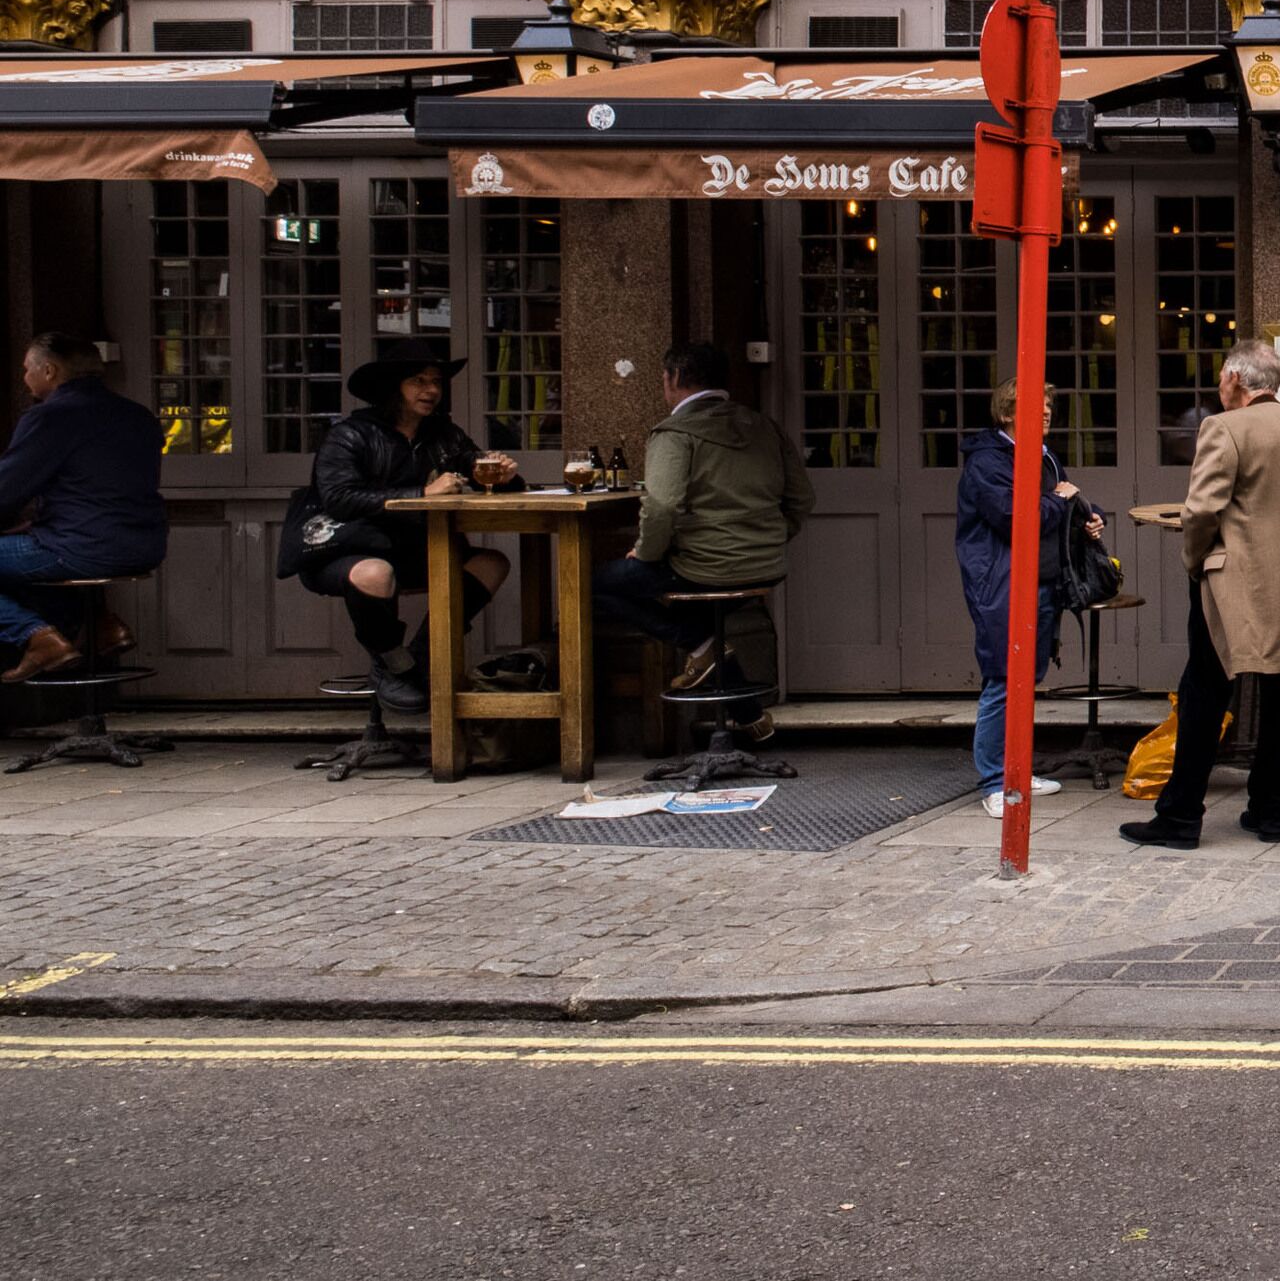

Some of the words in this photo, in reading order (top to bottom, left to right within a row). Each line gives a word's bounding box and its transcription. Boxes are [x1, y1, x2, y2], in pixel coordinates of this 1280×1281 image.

[700, 153, 750, 198] De
[763, 153, 870, 198] Hems
[888, 155, 968, 198] Cafe
